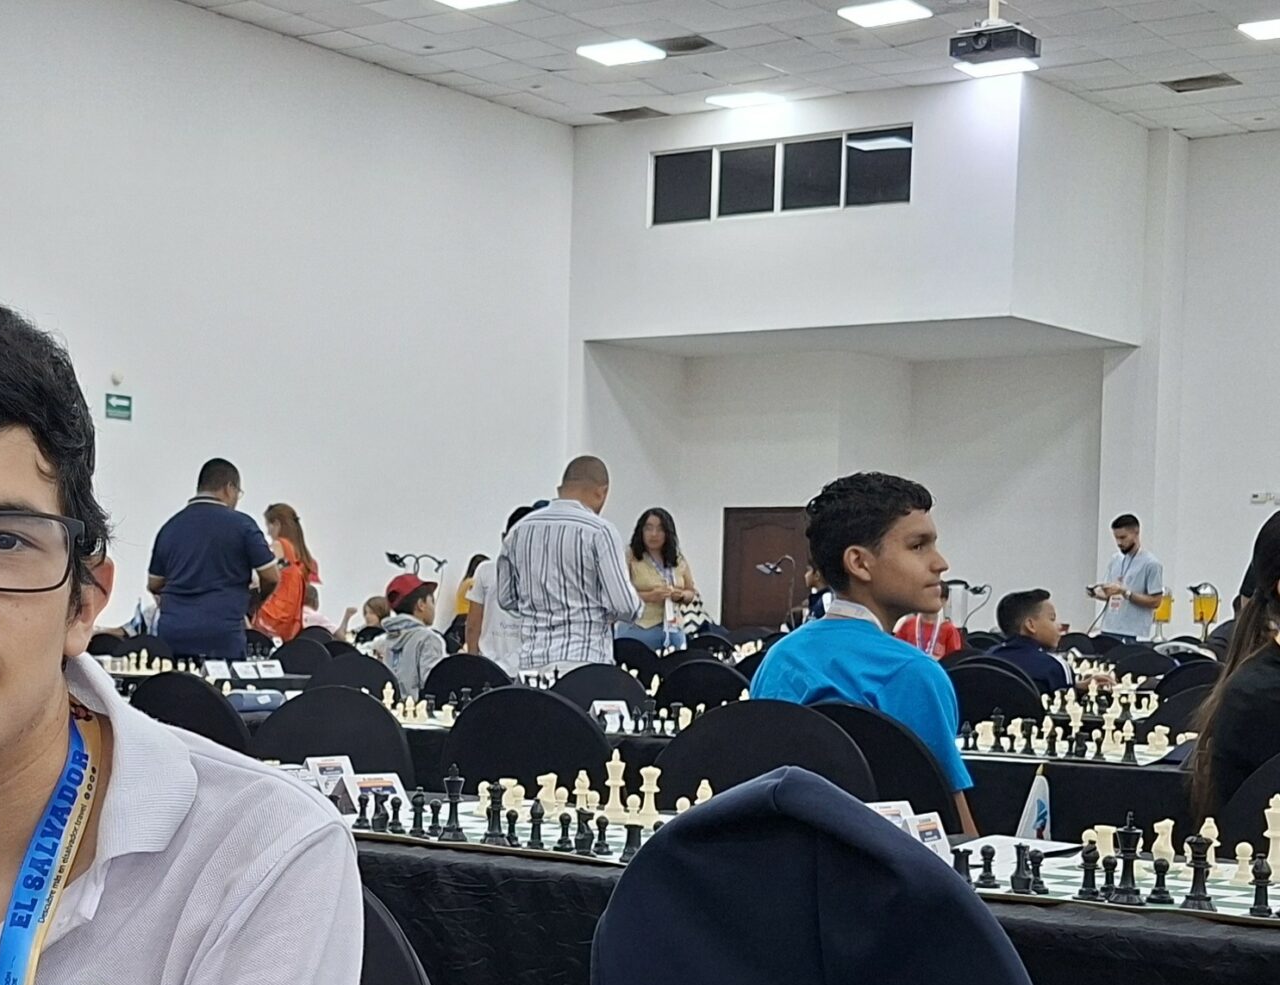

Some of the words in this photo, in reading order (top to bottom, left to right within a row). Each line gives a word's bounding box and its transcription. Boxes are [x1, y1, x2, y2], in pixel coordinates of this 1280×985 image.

[23, 750, 89, 891] SALVADOR
[9, 898, 39, 929] EL
[38, 890, 57, 924] Descubre
